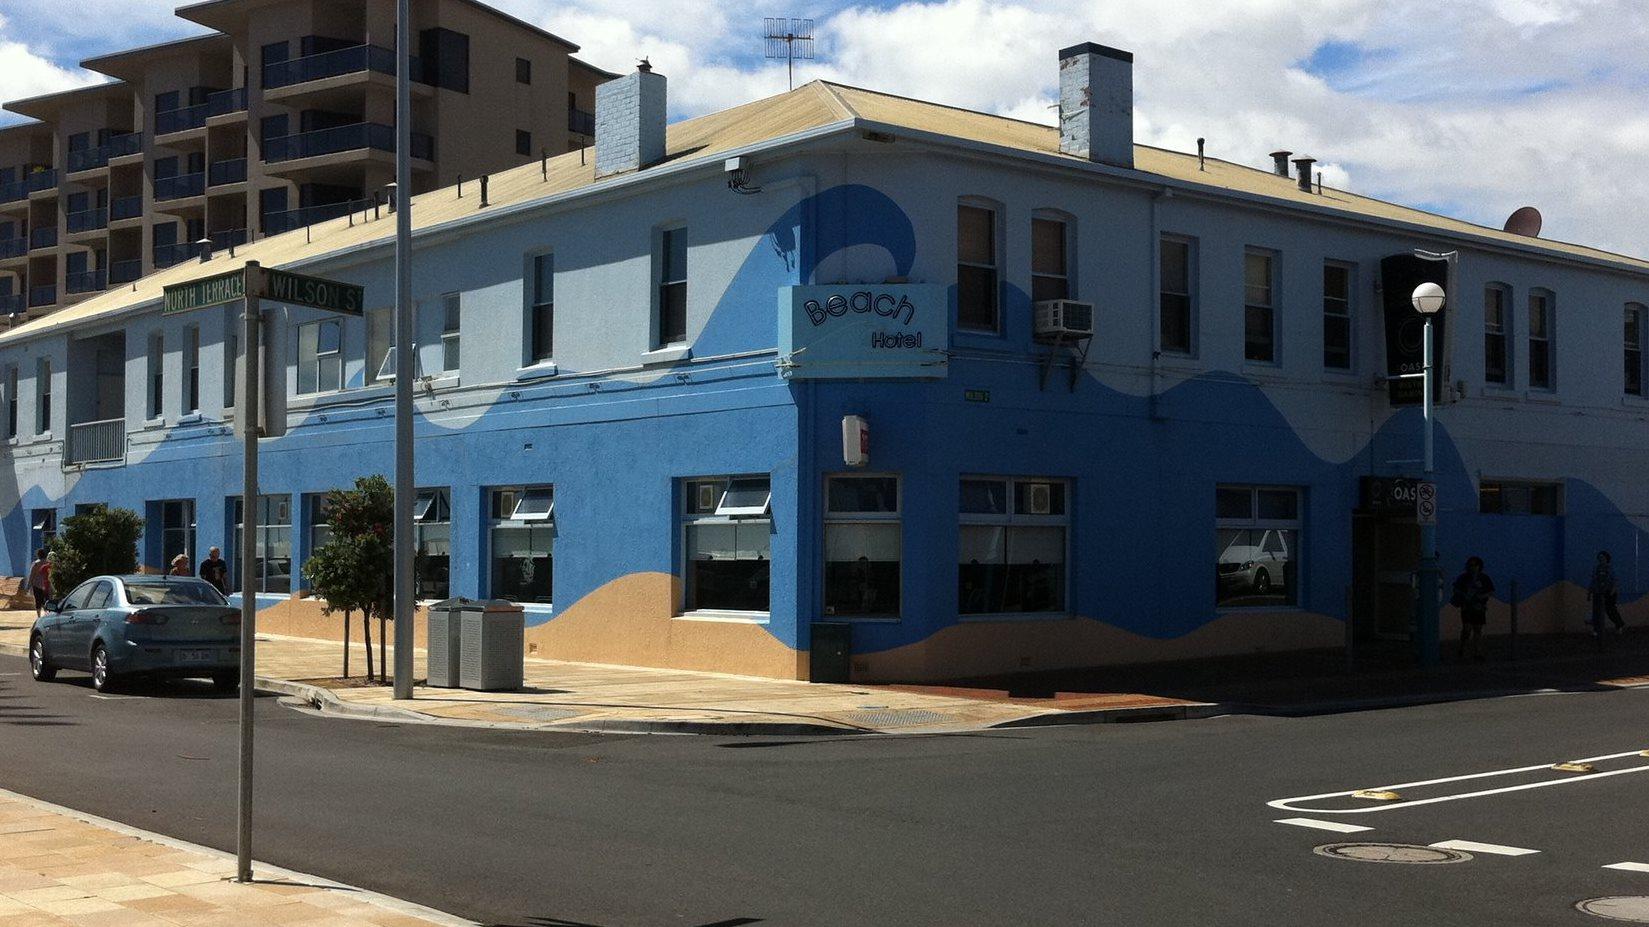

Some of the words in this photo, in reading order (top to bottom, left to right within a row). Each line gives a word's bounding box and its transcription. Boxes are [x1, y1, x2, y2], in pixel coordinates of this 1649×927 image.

[164, 288, 195, 312] NORTH
[202, 276, 241, 304] TERRACE
[272, 274, 340, 307] WILSON
[803, 292, 915, 327] Beach
[872, 331, 922, 349] Hotel
[1400, 362, 1421, 373] OAS
[1393, 487, 1416, 501] OAS
